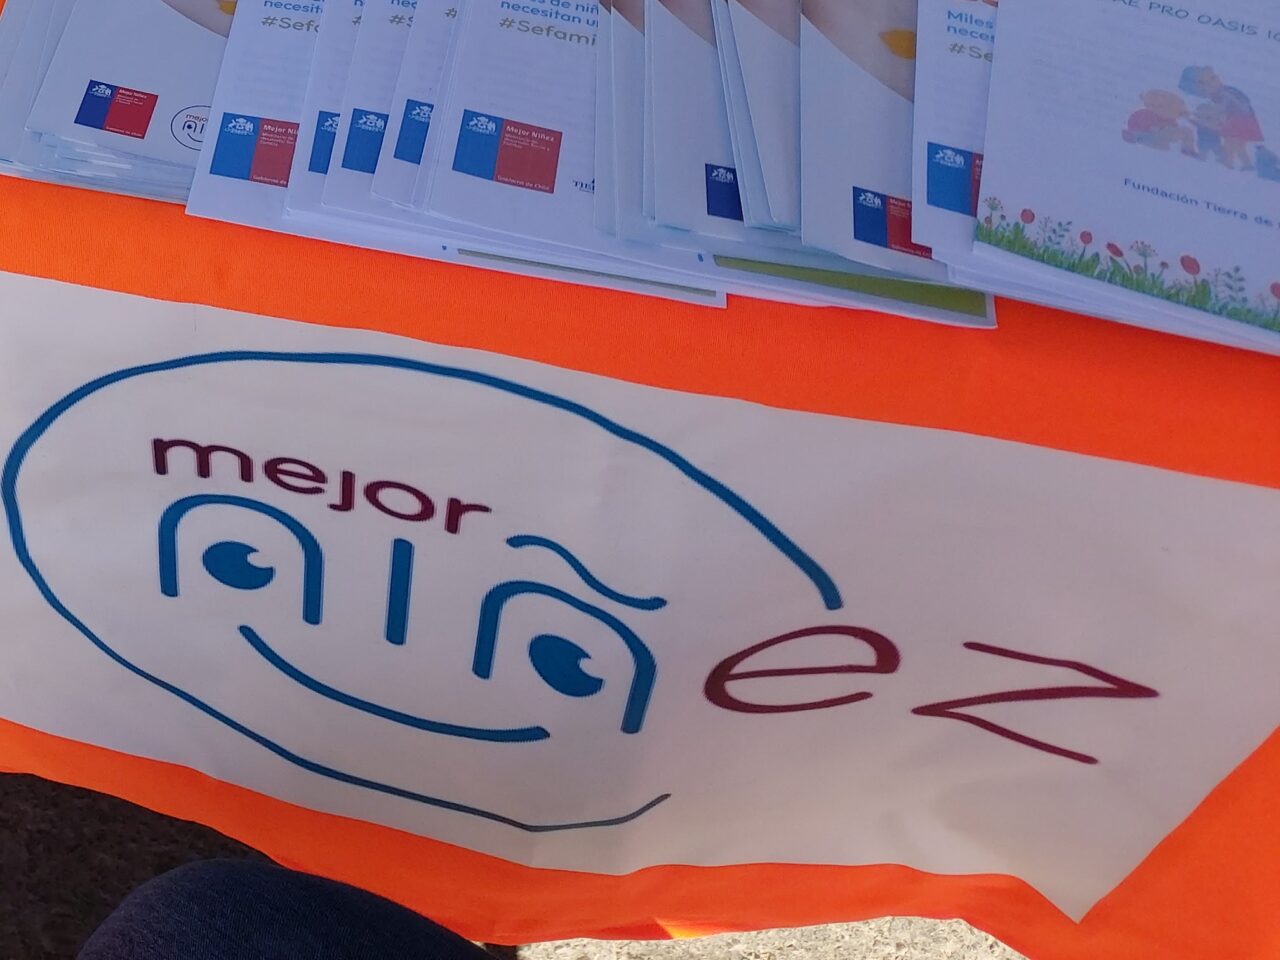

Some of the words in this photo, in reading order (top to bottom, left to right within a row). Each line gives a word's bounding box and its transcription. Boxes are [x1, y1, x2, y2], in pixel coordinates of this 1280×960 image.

[500, 0, 582, 25] necesitan
[947, 9, 995, 30] Miles
[1148, 1, 1190, 20] PRO
[1197, 13, 1259, 37] OASIS
[499, 16, 597, 47] #Sefami
[506, 125, 530, 137] Mejor
[1123, 177, 1199, 207] Fundación
[1204, 199, 1249, 221] Tierra
[1254, 215, 1274, 227] de
[152, 437, 493, 536] mejor
